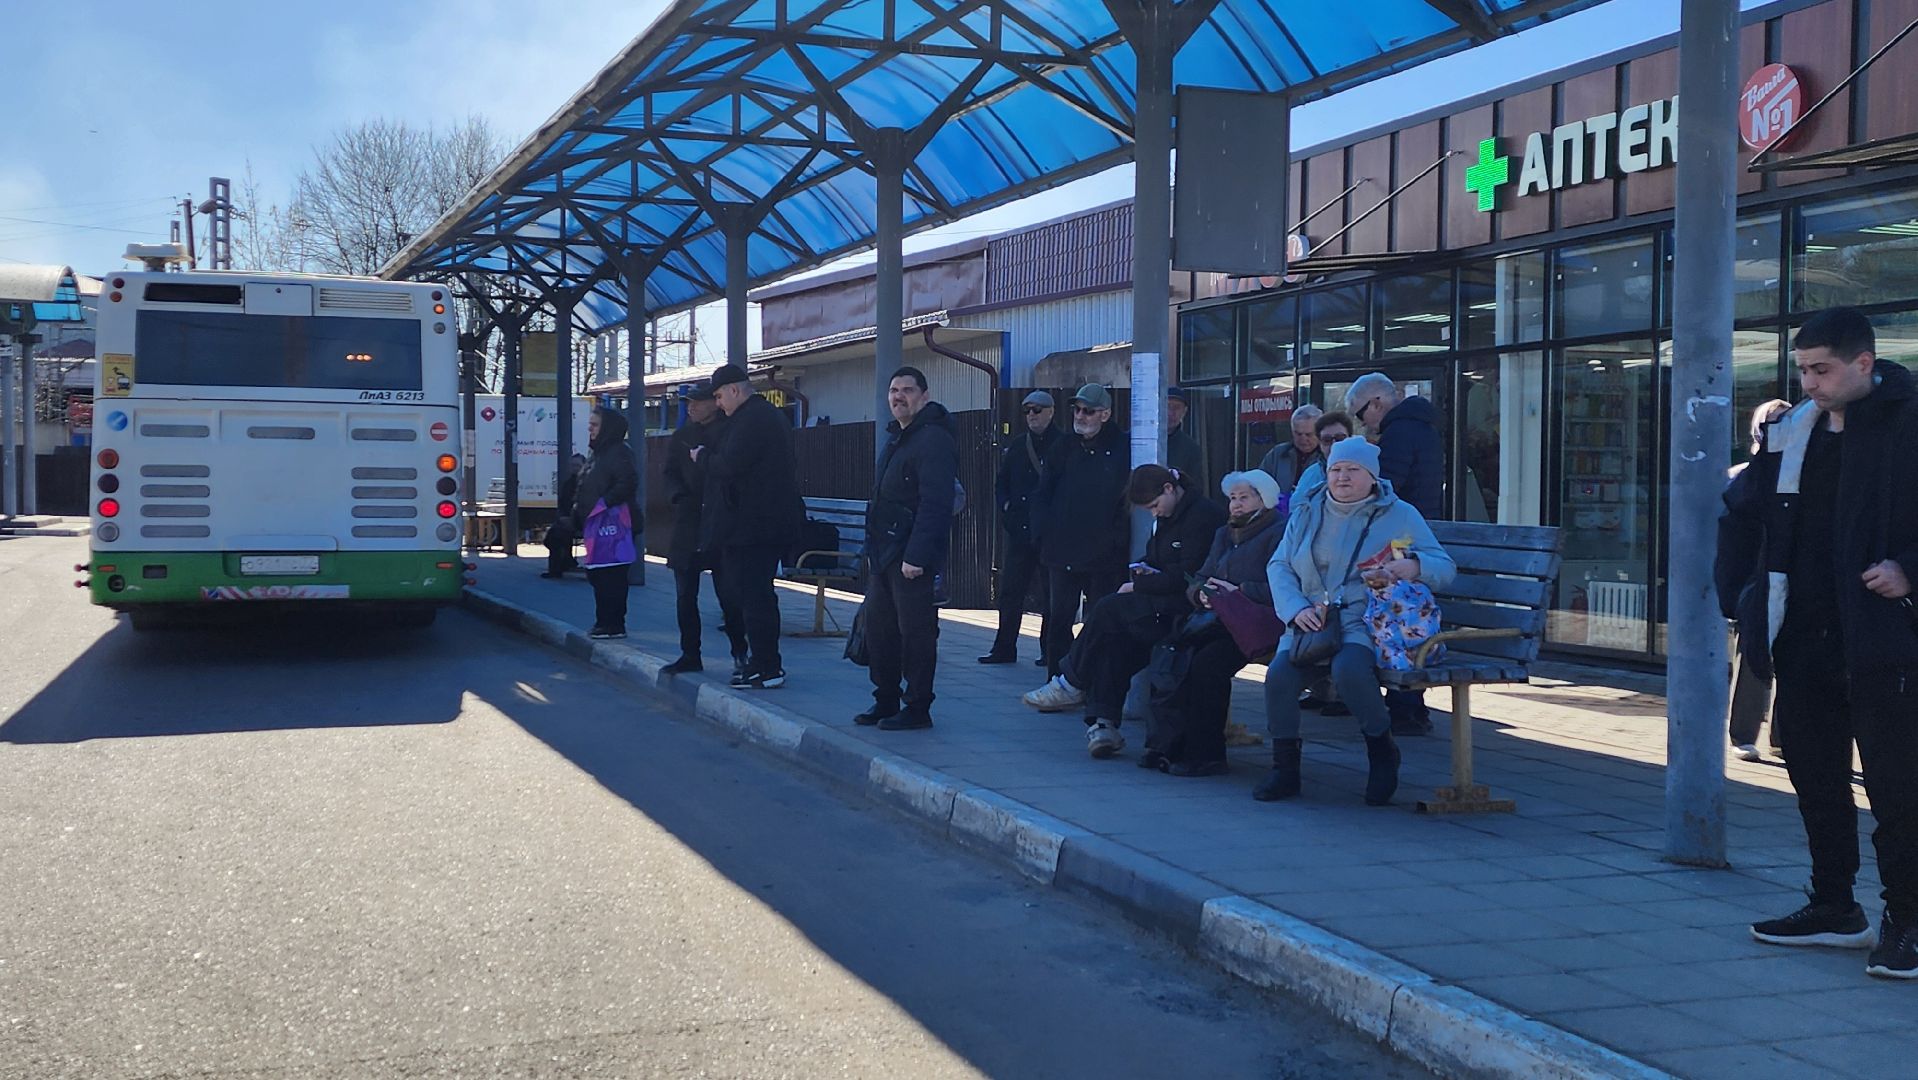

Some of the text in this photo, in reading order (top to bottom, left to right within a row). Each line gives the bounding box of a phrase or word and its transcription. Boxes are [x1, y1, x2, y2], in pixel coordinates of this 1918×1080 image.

[1517, 95, 1680, 198] АПТЕК
[395, 391, 425, 401] 6213
[598, 525, 618, 537] WB
